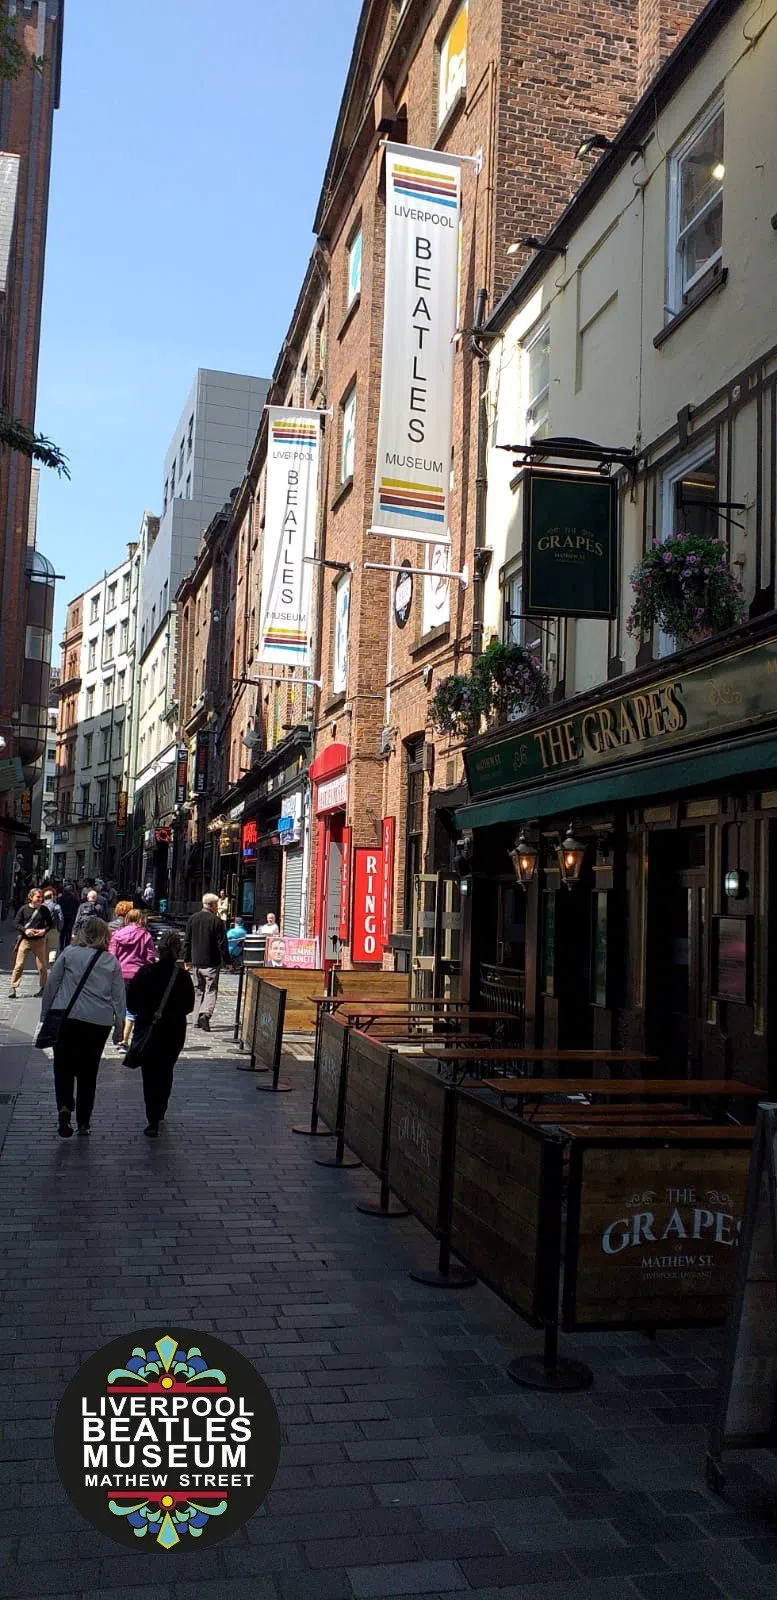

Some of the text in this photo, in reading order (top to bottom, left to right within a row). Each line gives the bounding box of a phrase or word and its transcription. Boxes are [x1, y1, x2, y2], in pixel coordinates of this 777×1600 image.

[394, 204, 454, 229] LIVERPOOL
[407, 236, 432, 443] BEATLES
[272, 451, 314, 462] LIVERPOOL
[386, 452, 443, 473] MUSEUM
[281, 469, 298, 604] BEATLES
[537, 535, 603, 556] GRAPES
[267, 611, 306, 622] MUSEUM
[535, 683, 686, 768] THE GRAPES
[364, 855, 377, 954] RINGO
[666, 1187, 696, 1204] THE
[641, 1256, 695, 1268] MATHEW
